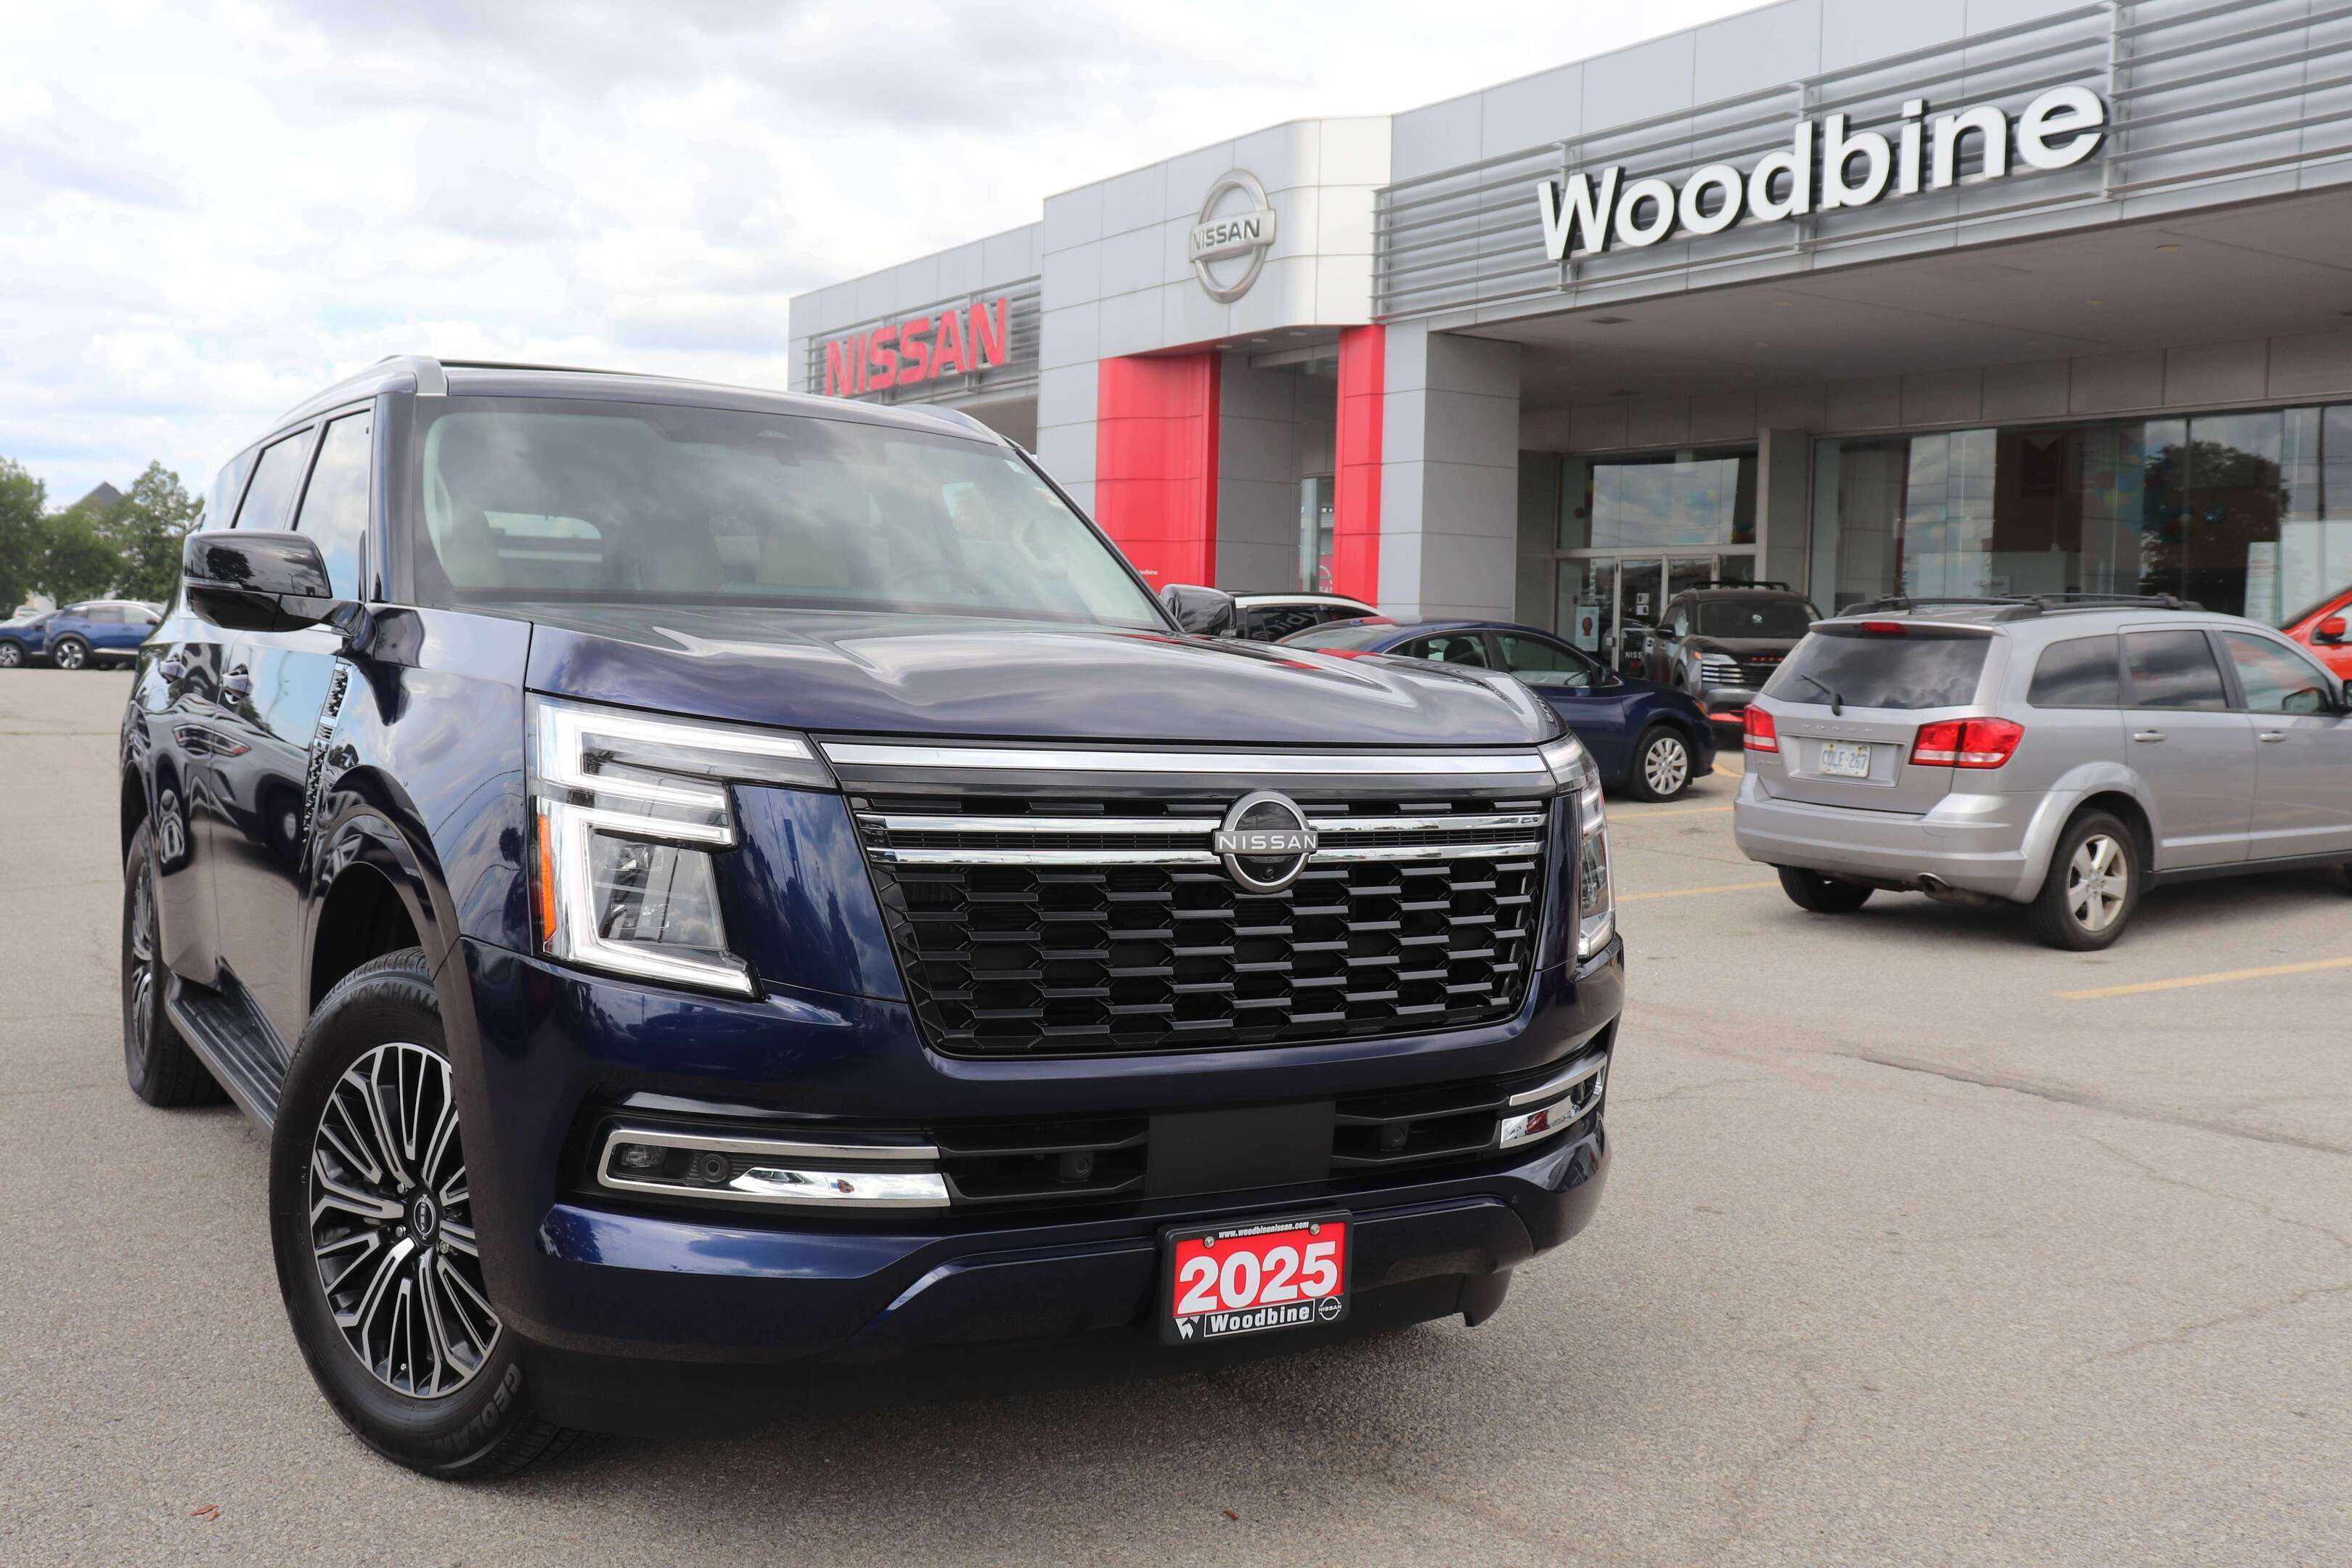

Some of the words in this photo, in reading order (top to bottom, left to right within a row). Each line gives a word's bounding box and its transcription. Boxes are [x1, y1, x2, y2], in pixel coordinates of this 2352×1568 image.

[1538, 83, 2106, 261] Woodbine
[1193, 218, 1259, 250] NISSAN
[825, 298, 1008, 397] NISSAN
[1219, 835, 1316, 849] NISSAN
[1219, 1221, 1309, 1238] www.woodbinenissan.com
[1177, 1241, 1338, 1315] 2025
[1210, 1304, 1310, 1333] Woodbine
[1318, 1304, 1342, 1312] NISSAN
